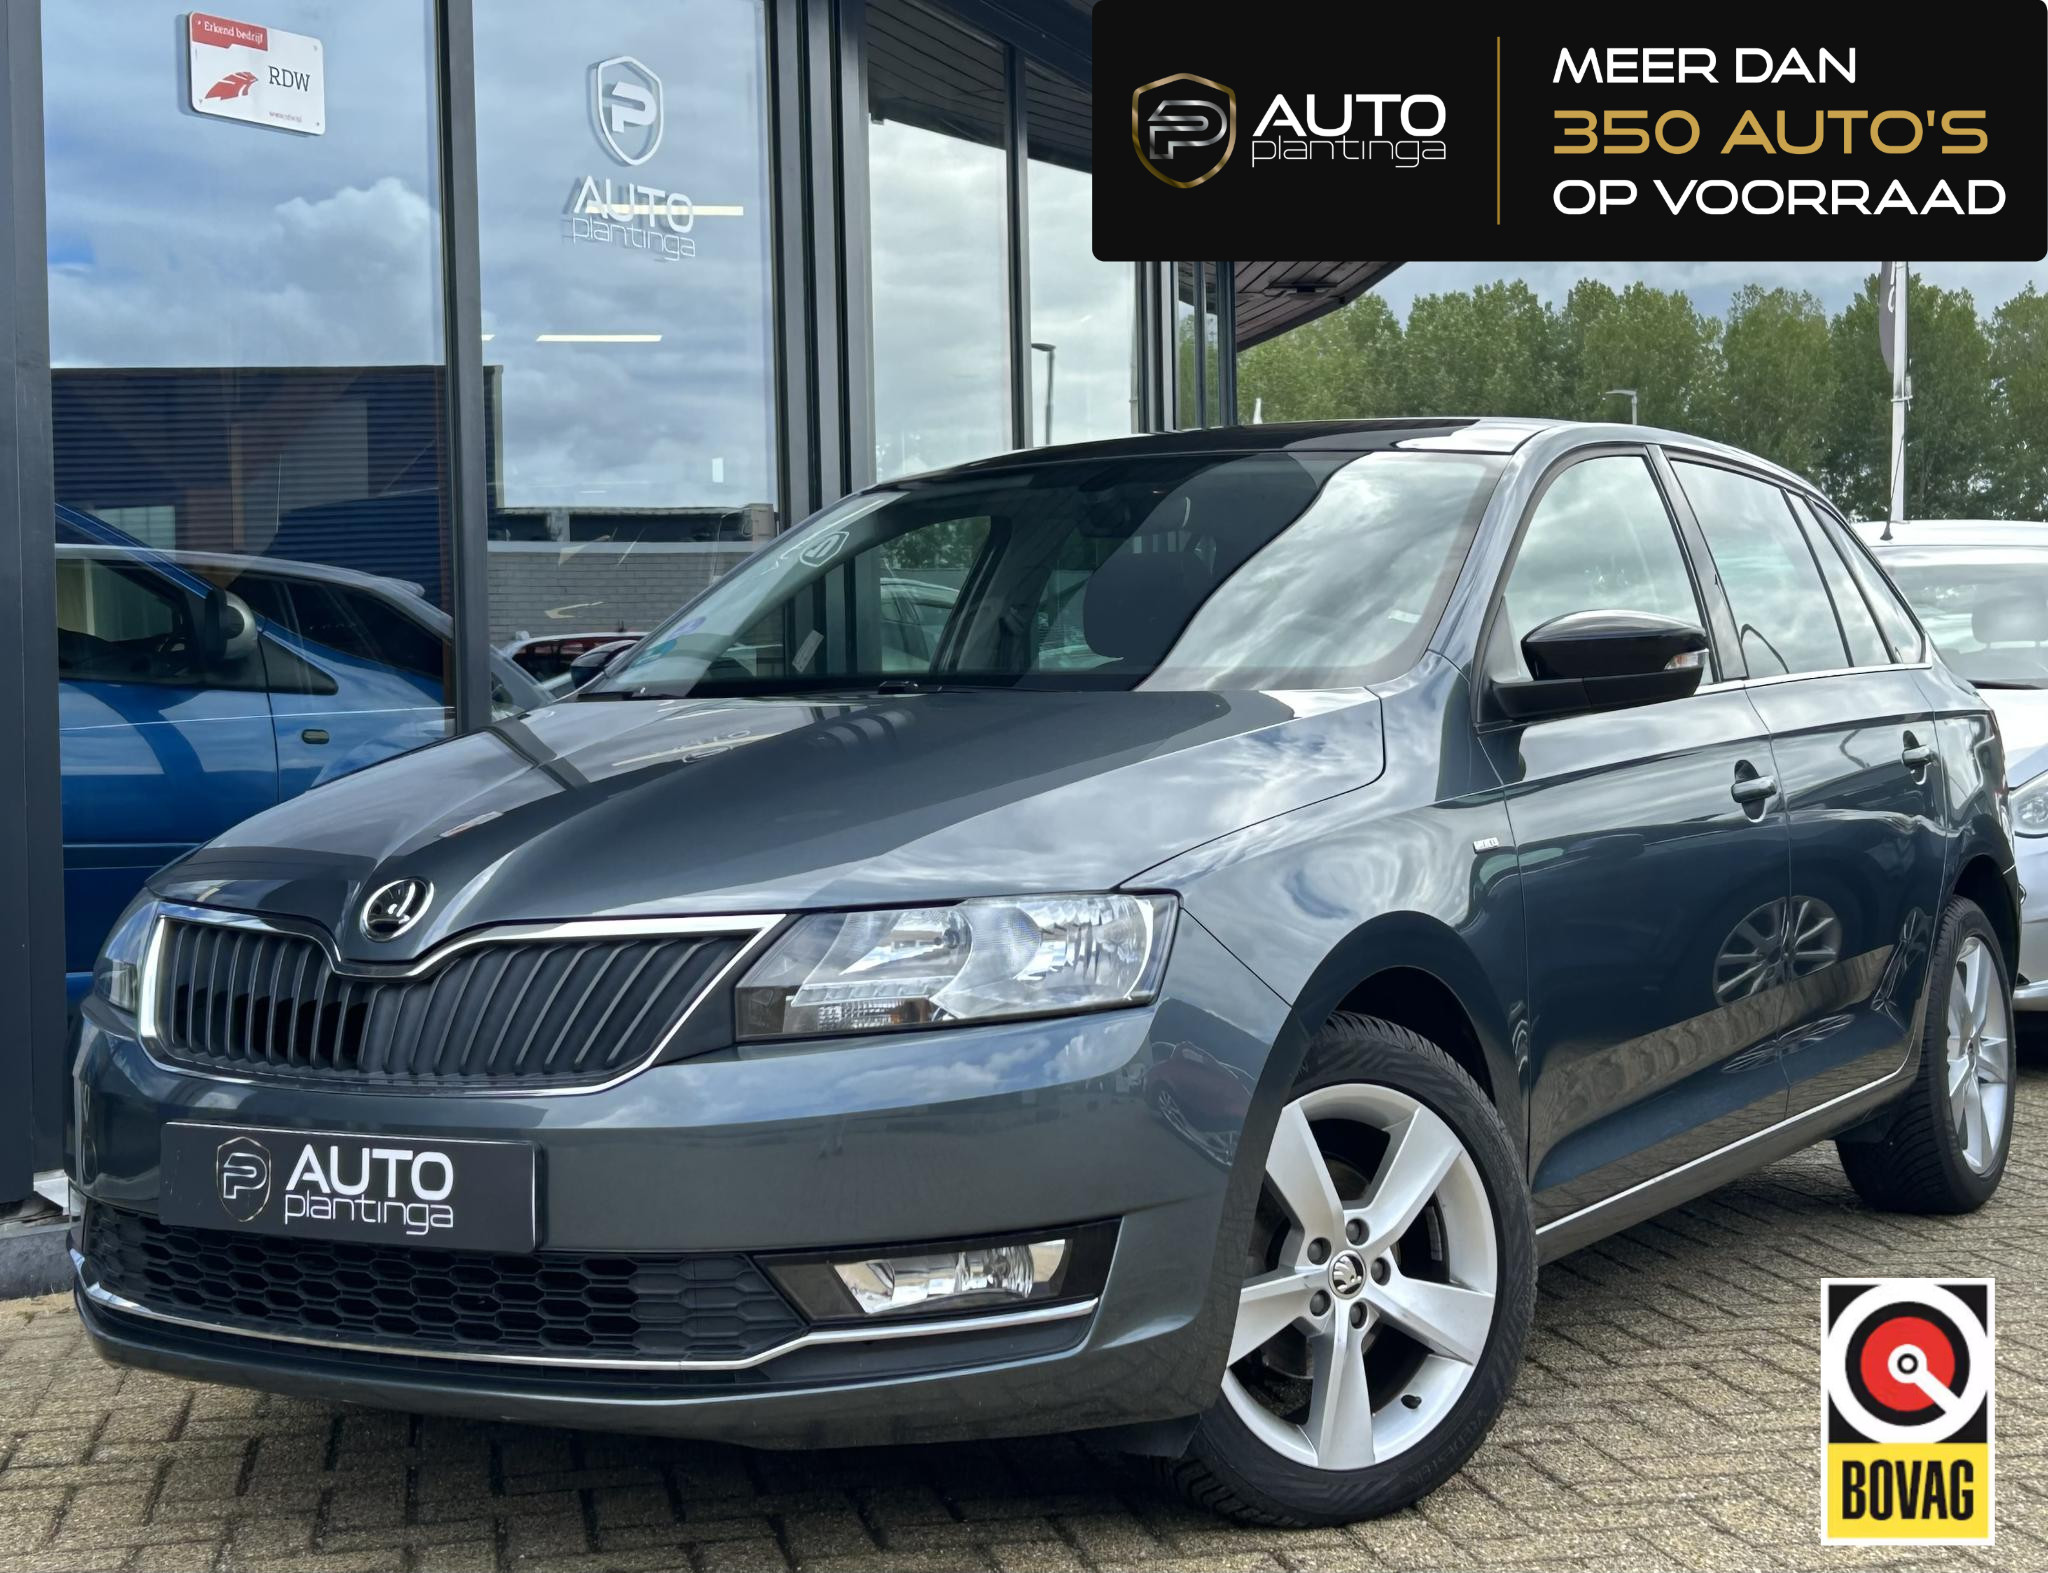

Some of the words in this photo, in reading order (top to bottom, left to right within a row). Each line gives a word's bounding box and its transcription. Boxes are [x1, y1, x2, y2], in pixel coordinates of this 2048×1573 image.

[204, 20, 234, 36] Erkend
[235, 28, 264, 45] bedrijf
[268, 65, 310, 92] RDW
[573, 175, 694, 233] AUTO
[572, 216, 696, 261] plantinga
[285, 1143, 454, 1201] AUTO
[284, 1190, 454, 1236] plantinga
